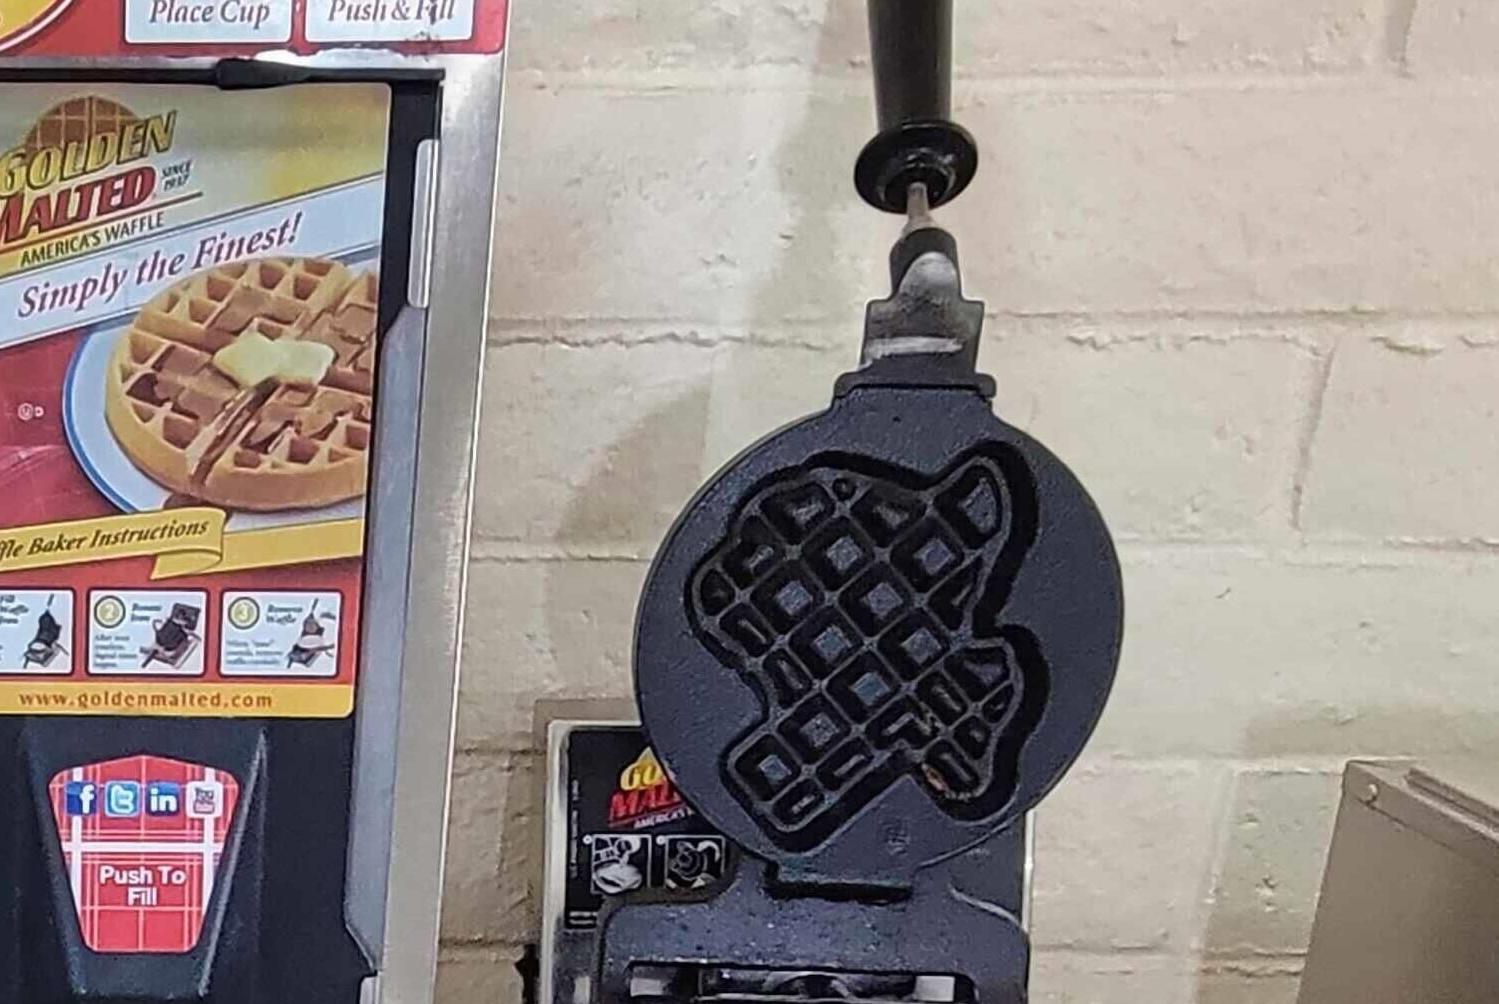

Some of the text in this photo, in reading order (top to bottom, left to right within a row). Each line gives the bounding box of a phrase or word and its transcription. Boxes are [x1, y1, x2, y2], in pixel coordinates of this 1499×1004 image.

[150, 0, 270, 29] Place Cup
[328, 0, 386, 22] Push
[391, 0, 411, 21] &
[20, 211, 164, 268] AMERICA'S WAFFLE
[17, 211, 303, 318] Simply the Finest!
[27, 534, 88, 556] Baker
[89, 518, 211, 549] Instructions
[19, 689, 273, 710] www.goldenmalted.com
[100, 866, 187, 885] Push To
[128, 887, 158, 906] Fill
